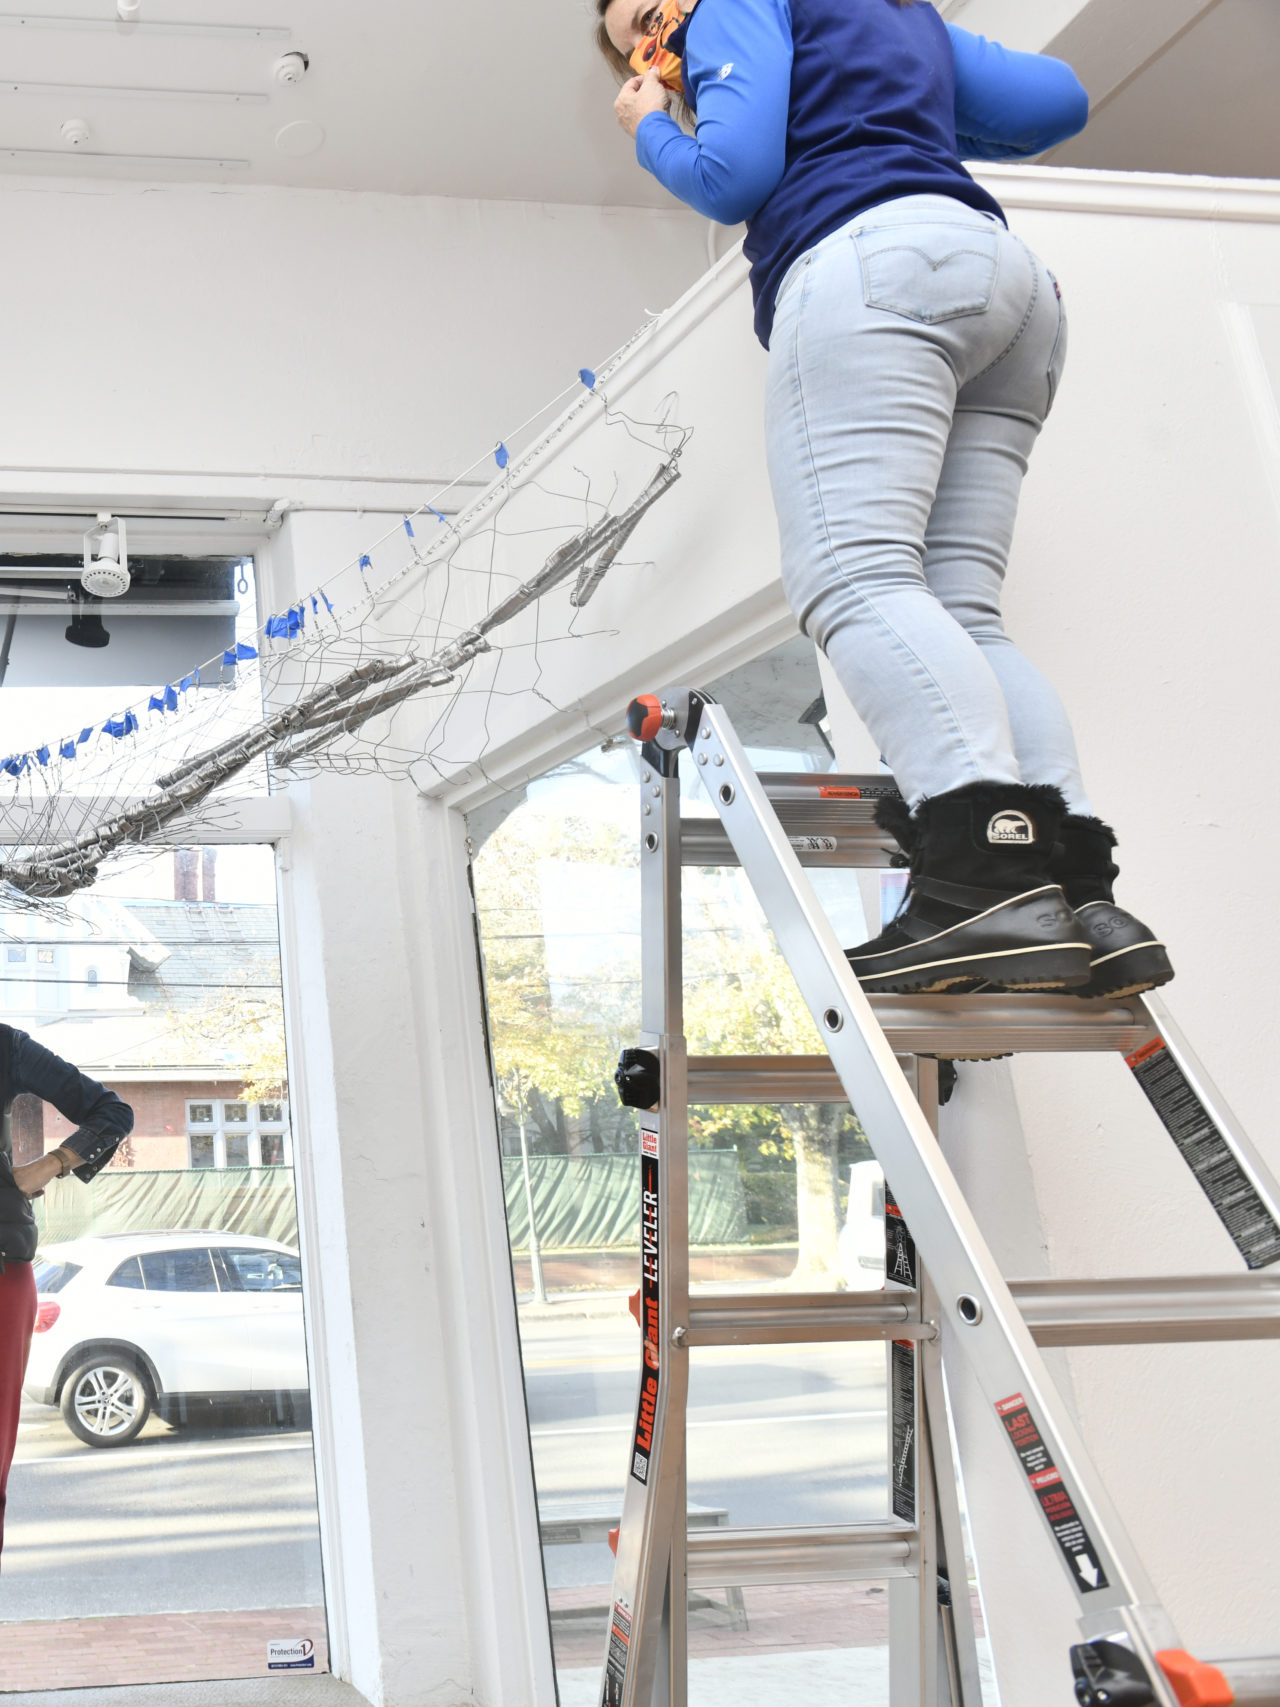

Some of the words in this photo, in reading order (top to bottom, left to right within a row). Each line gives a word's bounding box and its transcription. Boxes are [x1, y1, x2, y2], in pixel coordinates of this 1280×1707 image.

[642, 1131, 657, 1143] Little
[643, 1141, 657, 1153] Giant
[643, 1190, 658, 1283] LEVELER
[644, 1297, 659, 1371] Giant
[636, 1377, 658, 1451] Little
[1005, 1412, 1031, 1432] LAST
[270, 1648, 302, 1656] Protection
